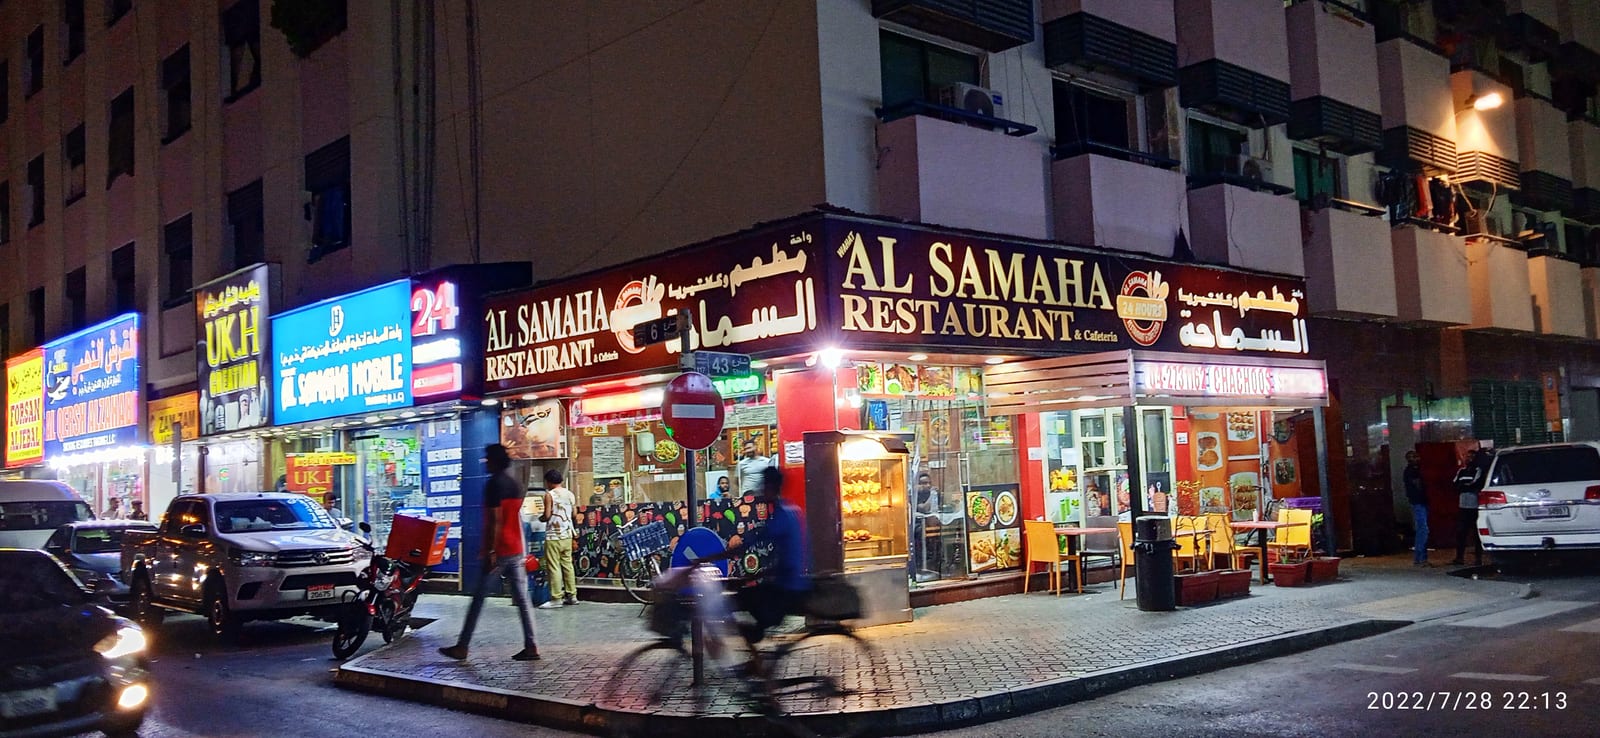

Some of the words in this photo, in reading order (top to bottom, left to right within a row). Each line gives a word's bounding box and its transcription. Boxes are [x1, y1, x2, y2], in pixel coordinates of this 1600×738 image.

[790, 231, 812, 245] واحة
[730, 242, 807, 297] مطعم
[841, 232, 913, 294] AL
[928, 242, 1114, 310] SAMAHA
[411, 281, 459, 336] 24
[486, 310, 513, 352] AL
[517, 288, 610, 347] SAMAHA
[666, 277, 817, 354] السما
[839, 293, 1075, 342] RESTAURANT
[1074, 329, 1082, 340] &
[1083, 330, 1118, 342] Cafeteria
[1122, 302, 1134, 315] 24
[1239, 285, 1299, 318] مطعم
[651, 323, 658, 340] 6
[1179, 309, 1309, 353] السماحة
[352, 353, 404, 396] MOBILE
[485, 338, 594, 381] RESTAURANT
[712, 358, 729, 373] 43
[10, 397, 40, 427] FORSAN
